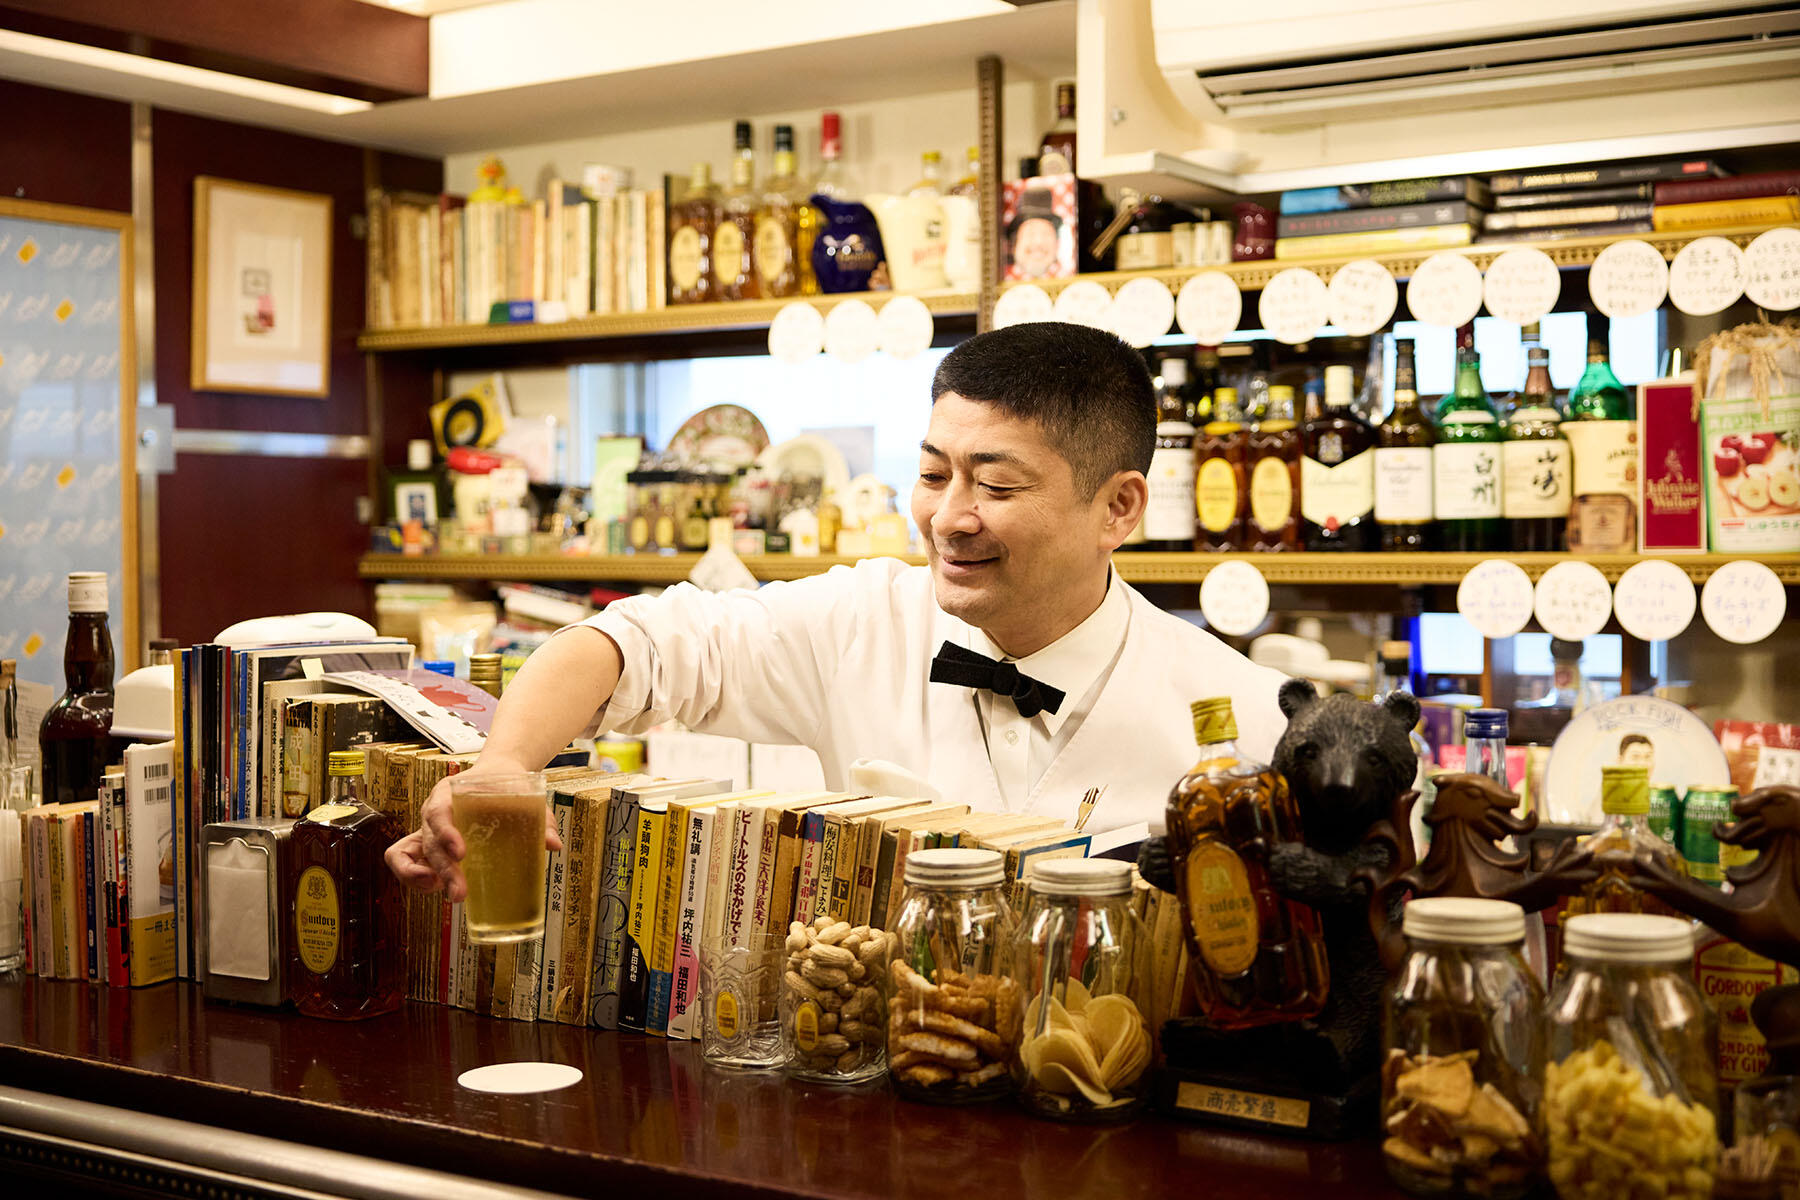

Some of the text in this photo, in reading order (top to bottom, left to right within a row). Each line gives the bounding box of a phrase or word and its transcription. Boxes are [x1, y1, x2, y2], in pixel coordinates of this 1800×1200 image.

[639, 819, 653, 869] 羊頭狗肉
[689, 817, 704, 856] 無礼講
[551, 809, 567, 911] ウイスー 起源への旅
[816, 826, 840, 914] 梅安料理ごよみ
[301, 910, 337, 930] Suntory
[679, 908, 695, 957] 坪内祐三
[674, 966, 690, 1015] 福田和也
[1719, 1041, 1765, 1057] ONDON
[1719, 1056, 1737, 1071] RY
[1205, 1090, 1276, 1118] 商売繁盛
